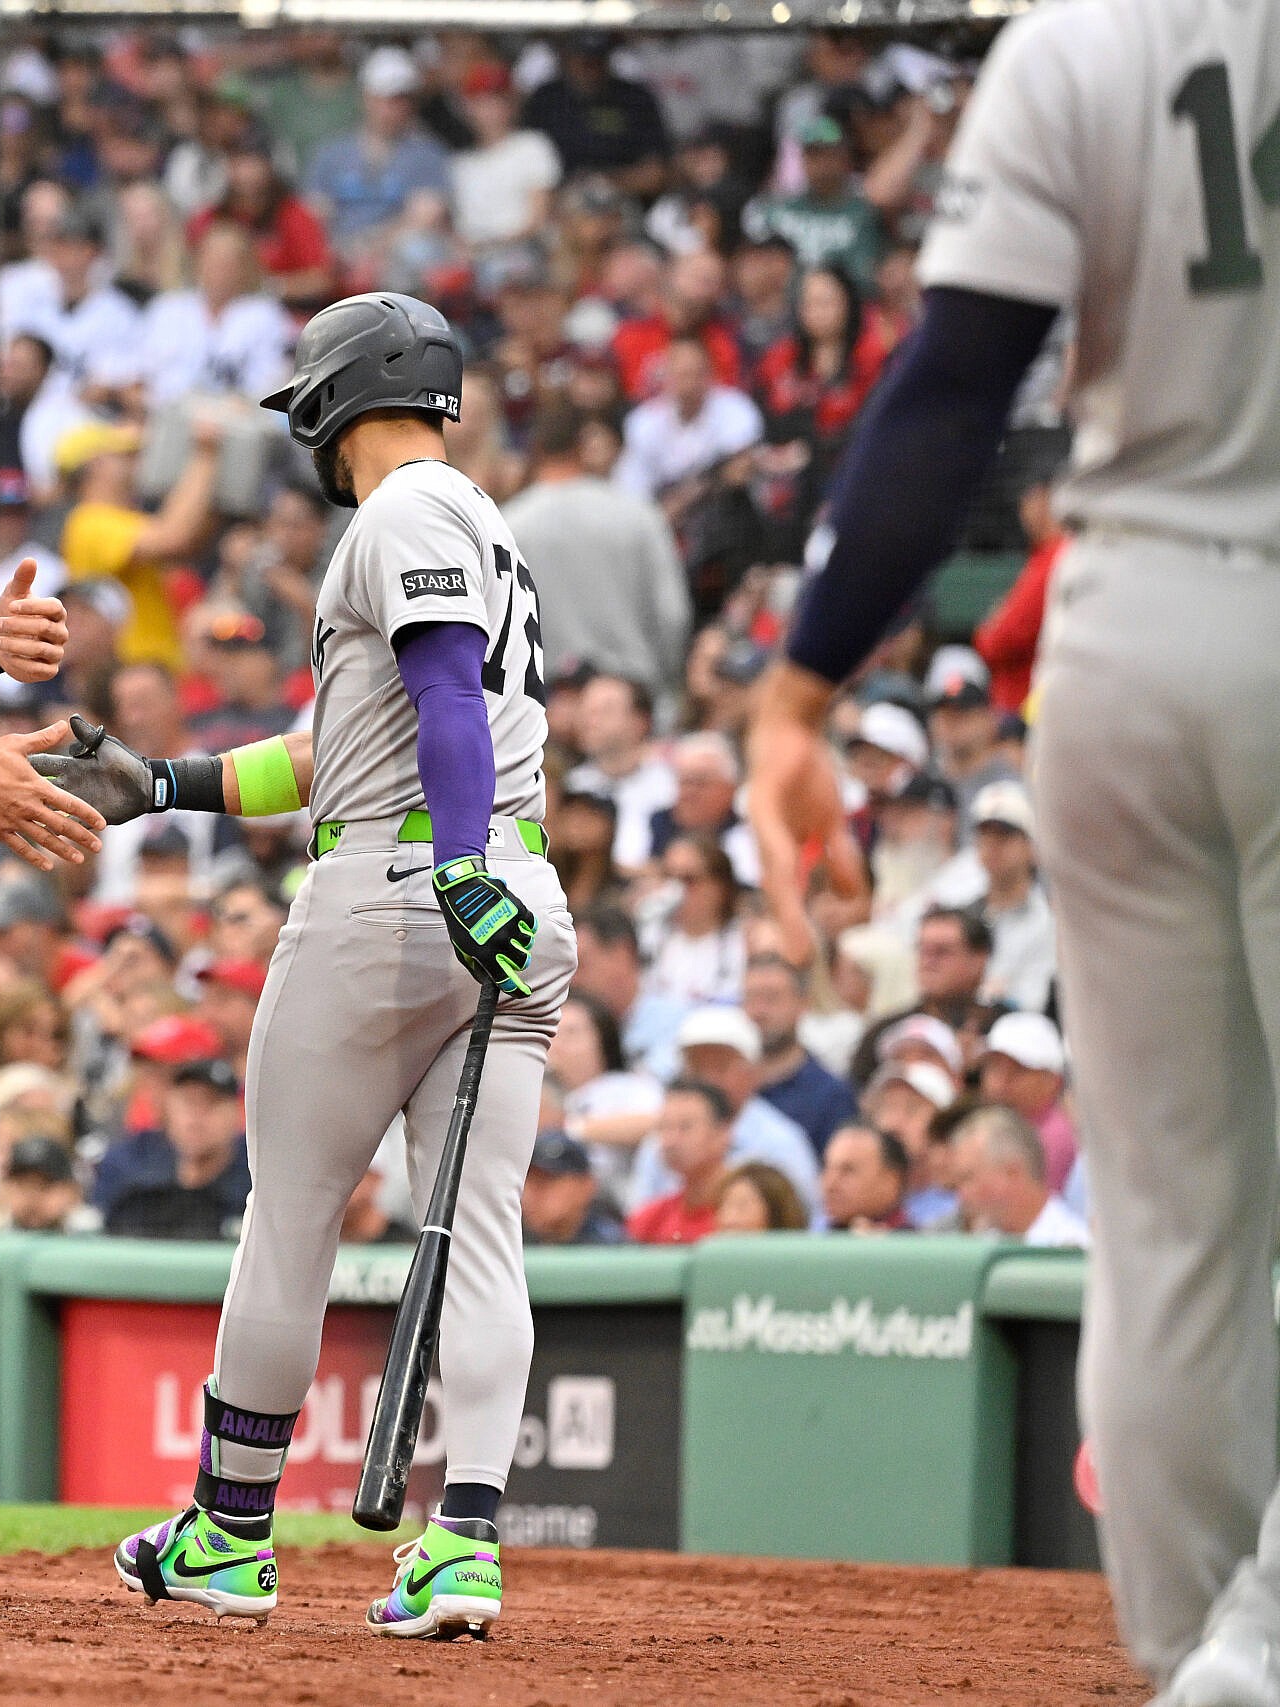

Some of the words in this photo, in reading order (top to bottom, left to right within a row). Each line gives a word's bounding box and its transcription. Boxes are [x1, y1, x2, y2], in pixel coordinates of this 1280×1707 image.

[1172, 58, 1280, 297] 1
[447, 395, 459, 417] 72
[404, 573, 466, 593] STARR
[481, 543, 547, 708] 72
[473, 901, 513, 940] Franklin
[261, 1572, 276, 1587] 72
